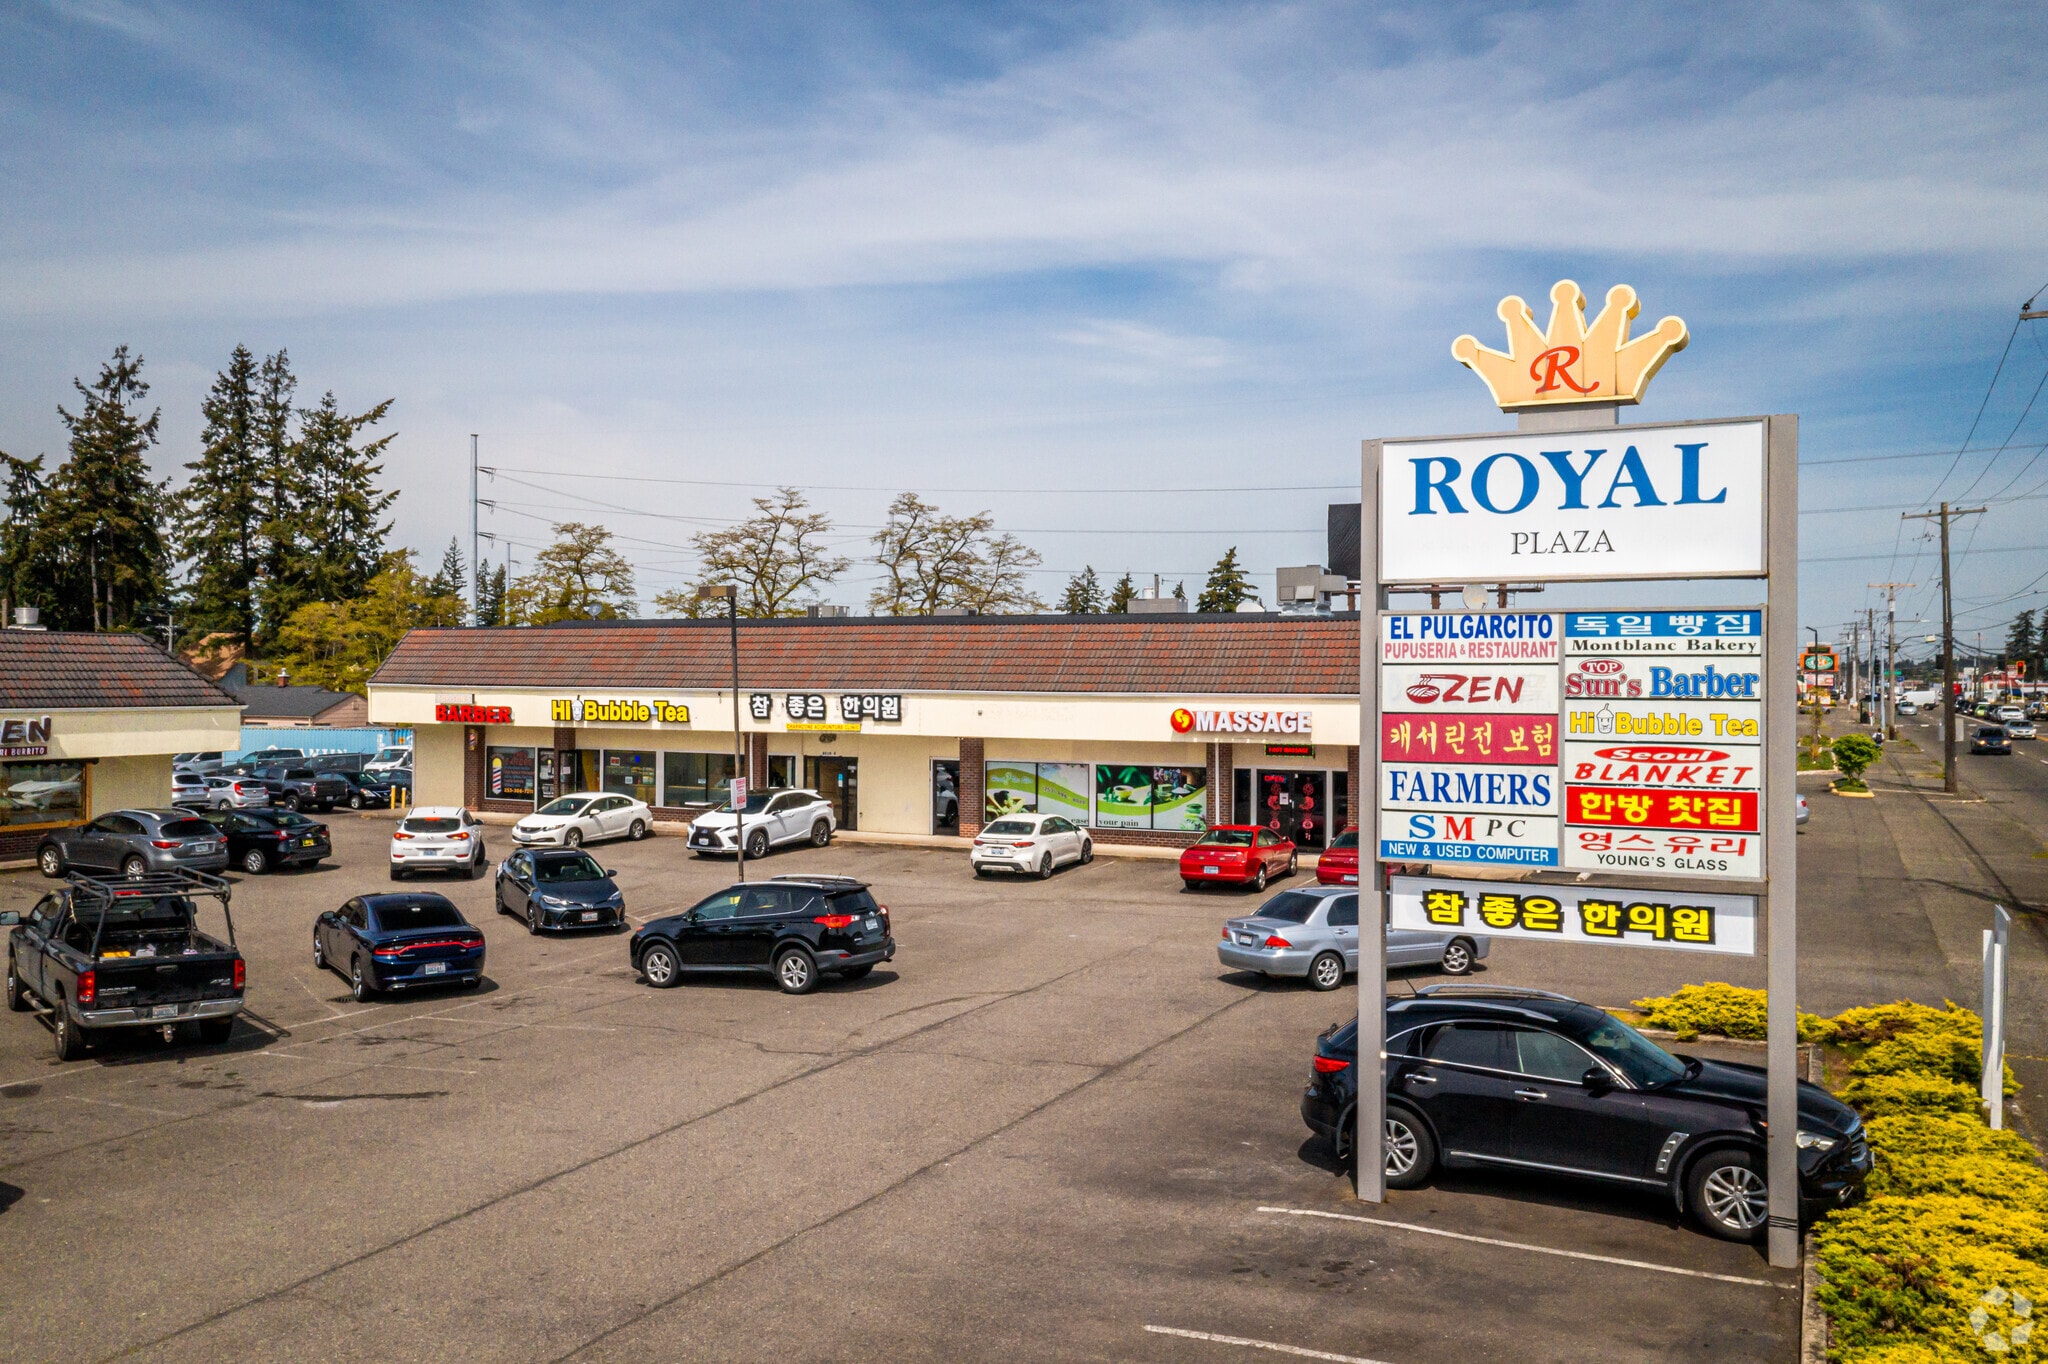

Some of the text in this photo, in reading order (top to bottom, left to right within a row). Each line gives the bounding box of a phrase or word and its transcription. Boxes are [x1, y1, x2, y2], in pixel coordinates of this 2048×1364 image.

[1530, 345, 1600, 394] R
[1408, 442, 1727, 515] ROYAL
[1510, 529, 1616, 554] PLAZA
[1390, 614, 1553, 640] EL PULGARCITO
[1573, 614, 1750, 636] 독일 빵집
[1385, 641, 1557, 659] PUPUSERIA & RESTAURANT
[1572, 639, 1757, 653] Montblanc Bakery
[1586, 662, 1617, 673] TOP
[1441, 674, 1525, 703] ZEN
[1565, 664, 1760, 698] Sun's Barber
[435, 704, 513, 724] BARBER
[584, 699, 651, 722] Bubble
[654, 700, 689, 722] Tea
[752, 695, 899, 719] 참 좋은 한의원
[1195, 711, 1313, 733] MASSAGE
[1569, 711, 1759, 737] Hi Bubble Tea
[11, 747, 45, 756] BURRITO
[1503, 723, 1553, 757] 보험
[1610, 749, 1713, 763] Seoul
[1574, 763, 1754, 785] BLANKET
[1389, 771, 1551, 806] FARMERS
[1579, 792, 1742, 826] 한방 찻집
[1121, 819, 1139, 827] pain
[1388, 842, 1549, 862] NEW & USED COMPUTER
[1597, 854, 1728, 871] YOUNG'S GLASS
[1427, 892, 1710, 941] 참 좋은 한의원
